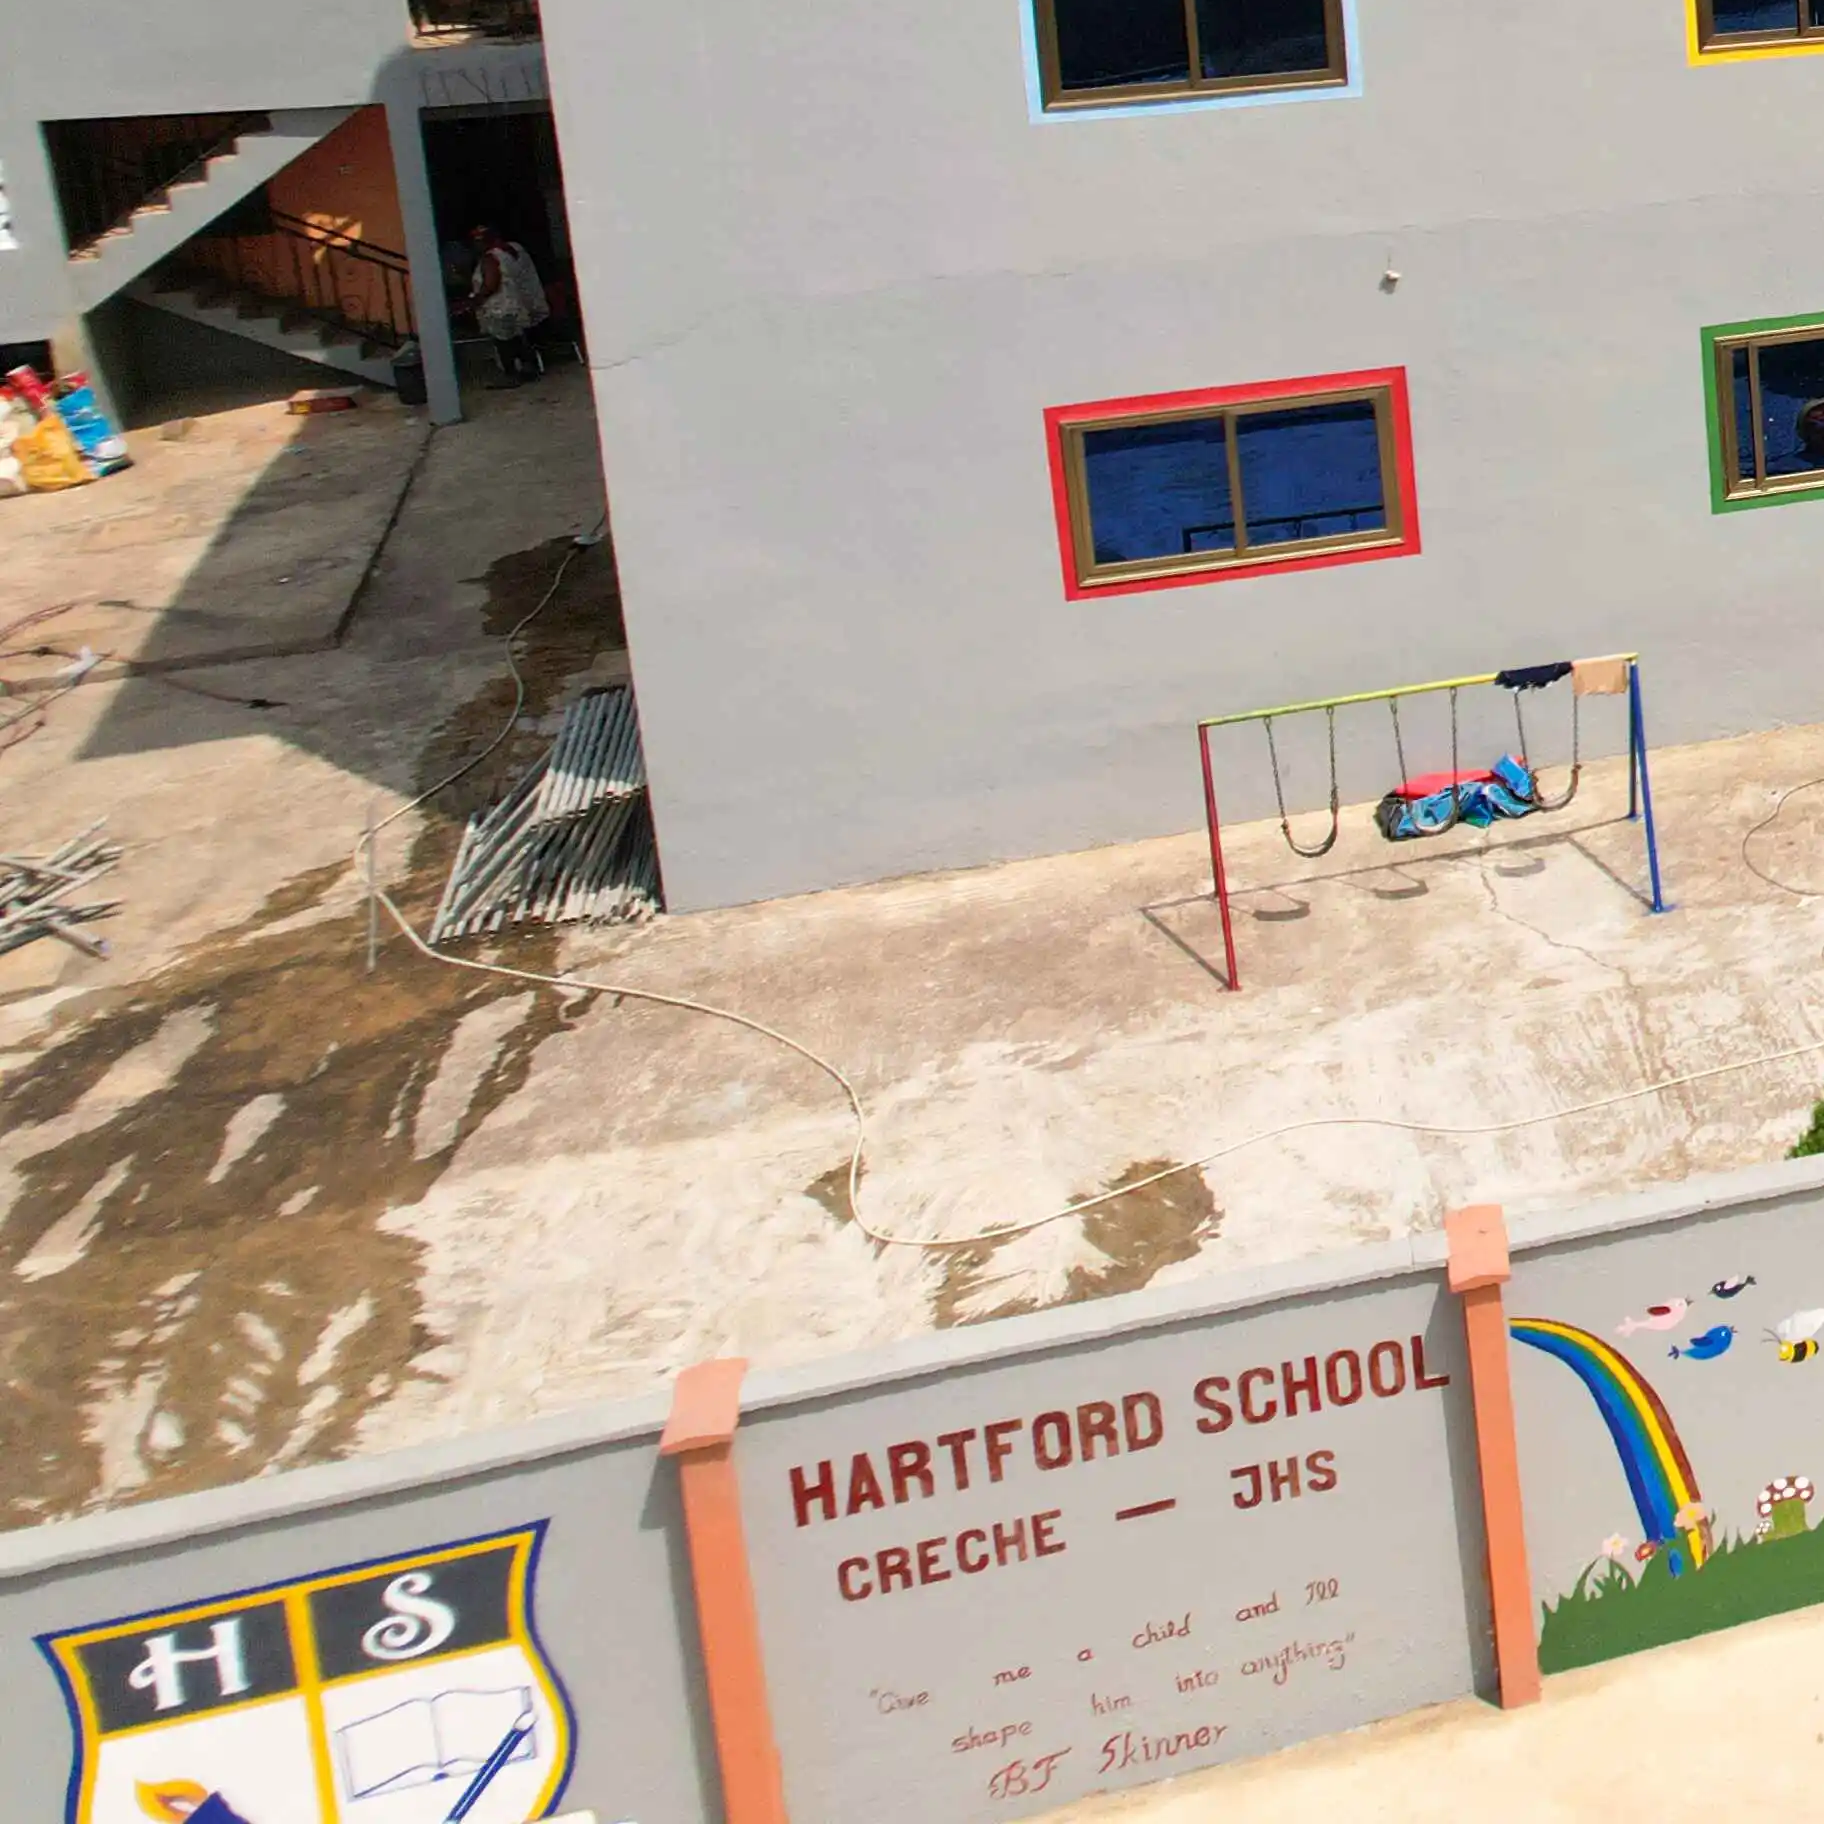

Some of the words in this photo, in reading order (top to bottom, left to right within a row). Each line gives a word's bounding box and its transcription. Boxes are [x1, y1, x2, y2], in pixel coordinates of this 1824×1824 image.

[788, 1391, 1163, 1528] HARTFORD
[1194, 1334, 1450, 1436] SCHOOL
[837, 1508, 1066, 1602] CRECHE
[1230, 1449, 1338, 1510] JHS
[128, 1617, 251, 1711] H
[362, 1571, 456, 1660] S
[992, 1666, 1032, 1686] me
[1077, 1648, 1094, 1662] a
[1132, 1612, 1192, 1649] child
[1235, 1591, 1281, 1622] and
[951, 1720, 1032, 1754] shape
[1091, 1692, 1132, 1717] him
[1175, 1669, 1219, 1694] into
[988, 1746, 1072, 1799] BF
[1098, 1725, 1227, 1775] Skinner
